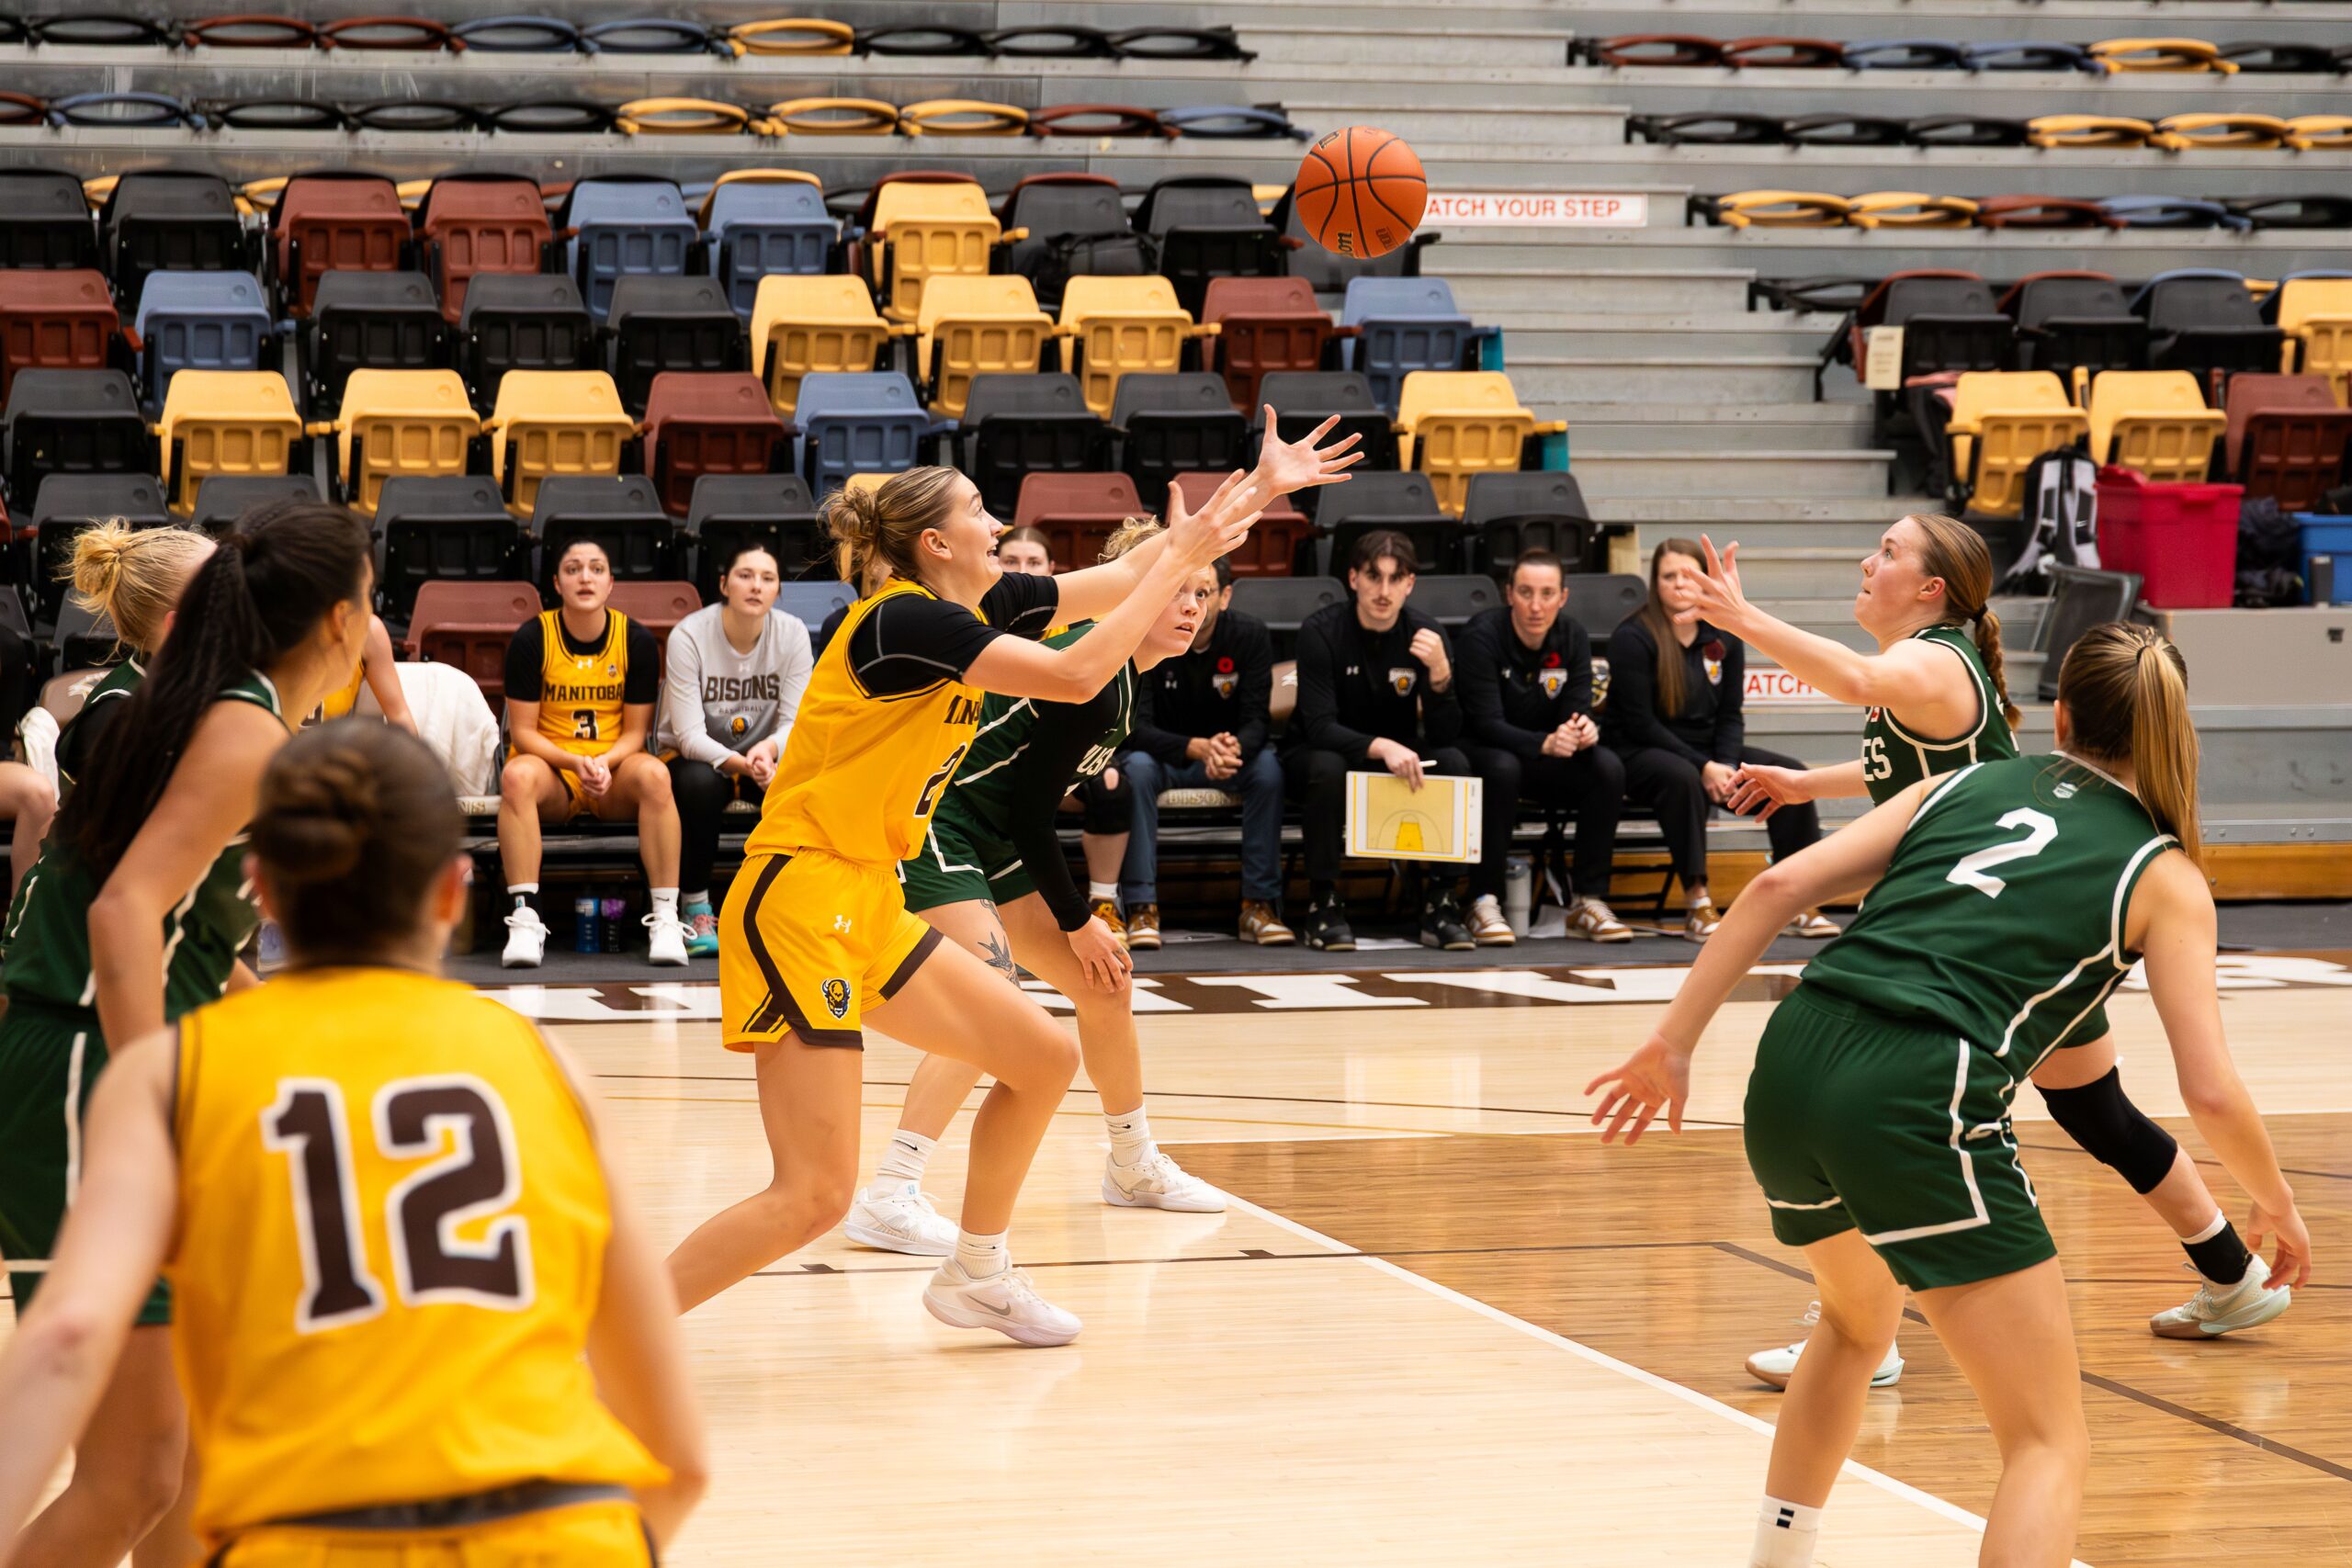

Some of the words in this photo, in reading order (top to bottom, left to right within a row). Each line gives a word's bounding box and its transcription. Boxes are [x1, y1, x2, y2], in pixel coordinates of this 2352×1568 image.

[1427, 198, 1485, 216] ATCH
[1494, 198, 1555, 217] YOUR
[1564, 199, 1621, 217] STEP
[545, 682, 623, 702] MANITOBA
[704, 673, 780, 702] BISONS
[1743, 674, 1812, 694] ATCH
[571, 709, 599, 740] 3
[912, 741, 968, 818] 2
[1945, 807, 2059, 899] 2
[258, 1073, 537, 1336] 12
